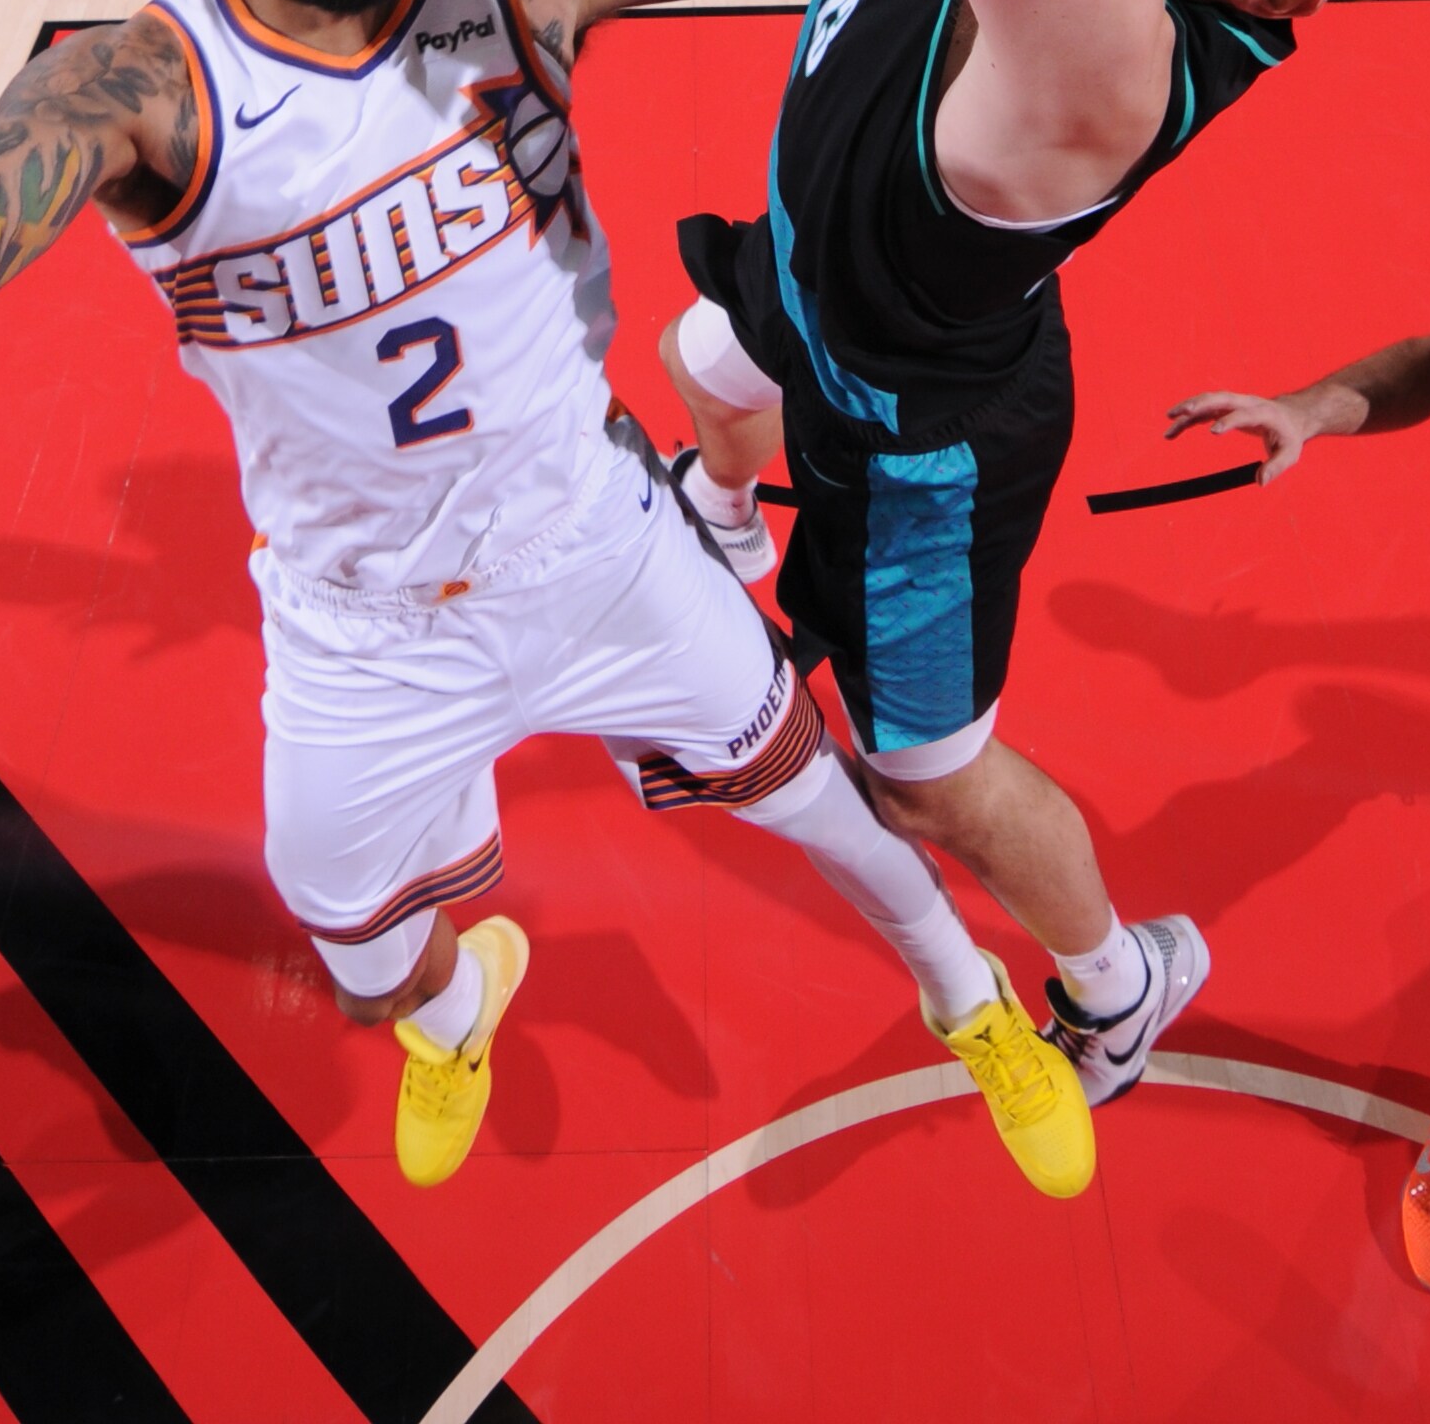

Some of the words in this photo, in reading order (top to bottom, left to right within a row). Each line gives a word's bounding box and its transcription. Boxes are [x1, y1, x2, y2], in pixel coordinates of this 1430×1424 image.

[415, 13, 496, 54] PayPal
[213, 138, 511, 343] SUNS
[376, 316, 474, 449] 2
